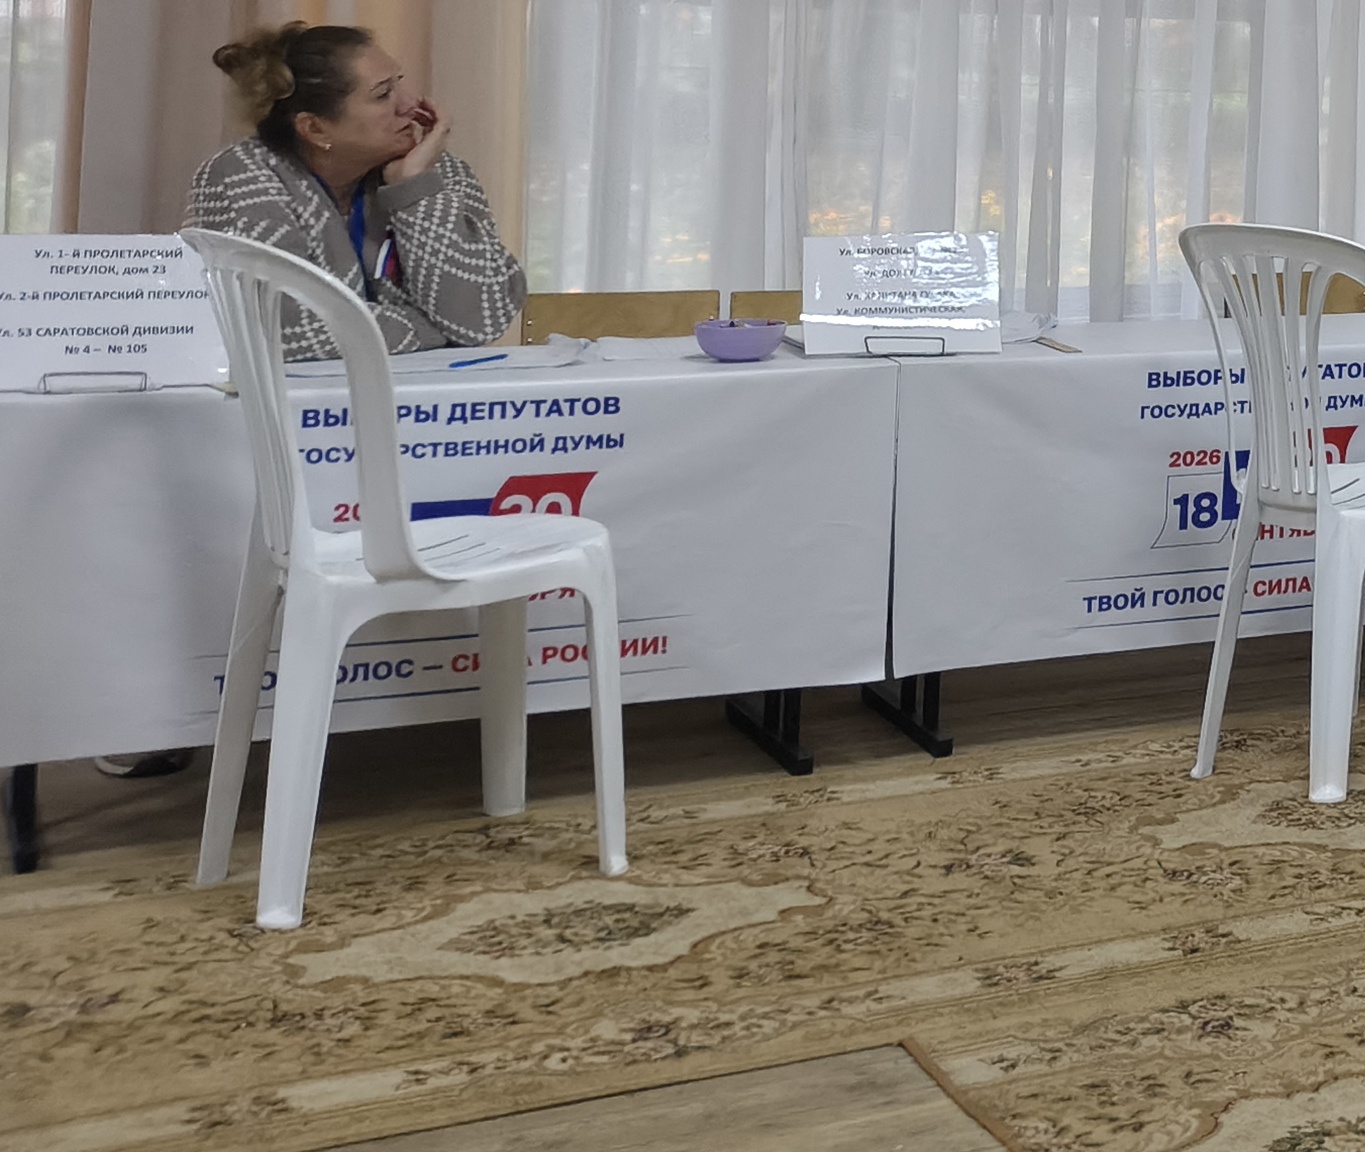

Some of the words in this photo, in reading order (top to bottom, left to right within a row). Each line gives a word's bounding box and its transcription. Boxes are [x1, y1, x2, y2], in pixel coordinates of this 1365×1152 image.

[34, 249, 54, 259] Ул.
[83, 247, 183, 259] ПРОЛЕТАРСКИЙ
[50, 265, 120, 276] ПЕРЕУЛОК,
[122, 266, 149, 275] дом
[152, 265, 167, 275] 23
[19, 291, 40, 301] 2-й
[43, 289, 144, 300] ПРОЛЕТАРСКИЙ
[18, 328, 32, 337] 53
[35, 325, 129, 337] САРАТОВСКОЙ
[132, 325, 194, 338] ДИВИЗИИ
[64, 345, 80, 355] №
[82, 345, 91, 354] 4
[107, 344, 123, 354] №
[126, 344, 148, 354] 105
[1147, 368, 1246, 389] ВЫБОРЫ
[301, 403, 438, 429] ВЫРЫ
[446, 396, 621, 425] ДЕПУТАТОВ
[551, 432, 625, 455] ДУМЫ
[1168, 449, 1221, 468] 2026
[1173, 491, 1219, 530] 18
[1082, 587, 1146, 614] ТВОЙ
[1151, 583, 1226, 607] ГОЛОС
[1253, 576, 1312, 598] СИЛА
[336, 658, 415, 686] ОЛОС
